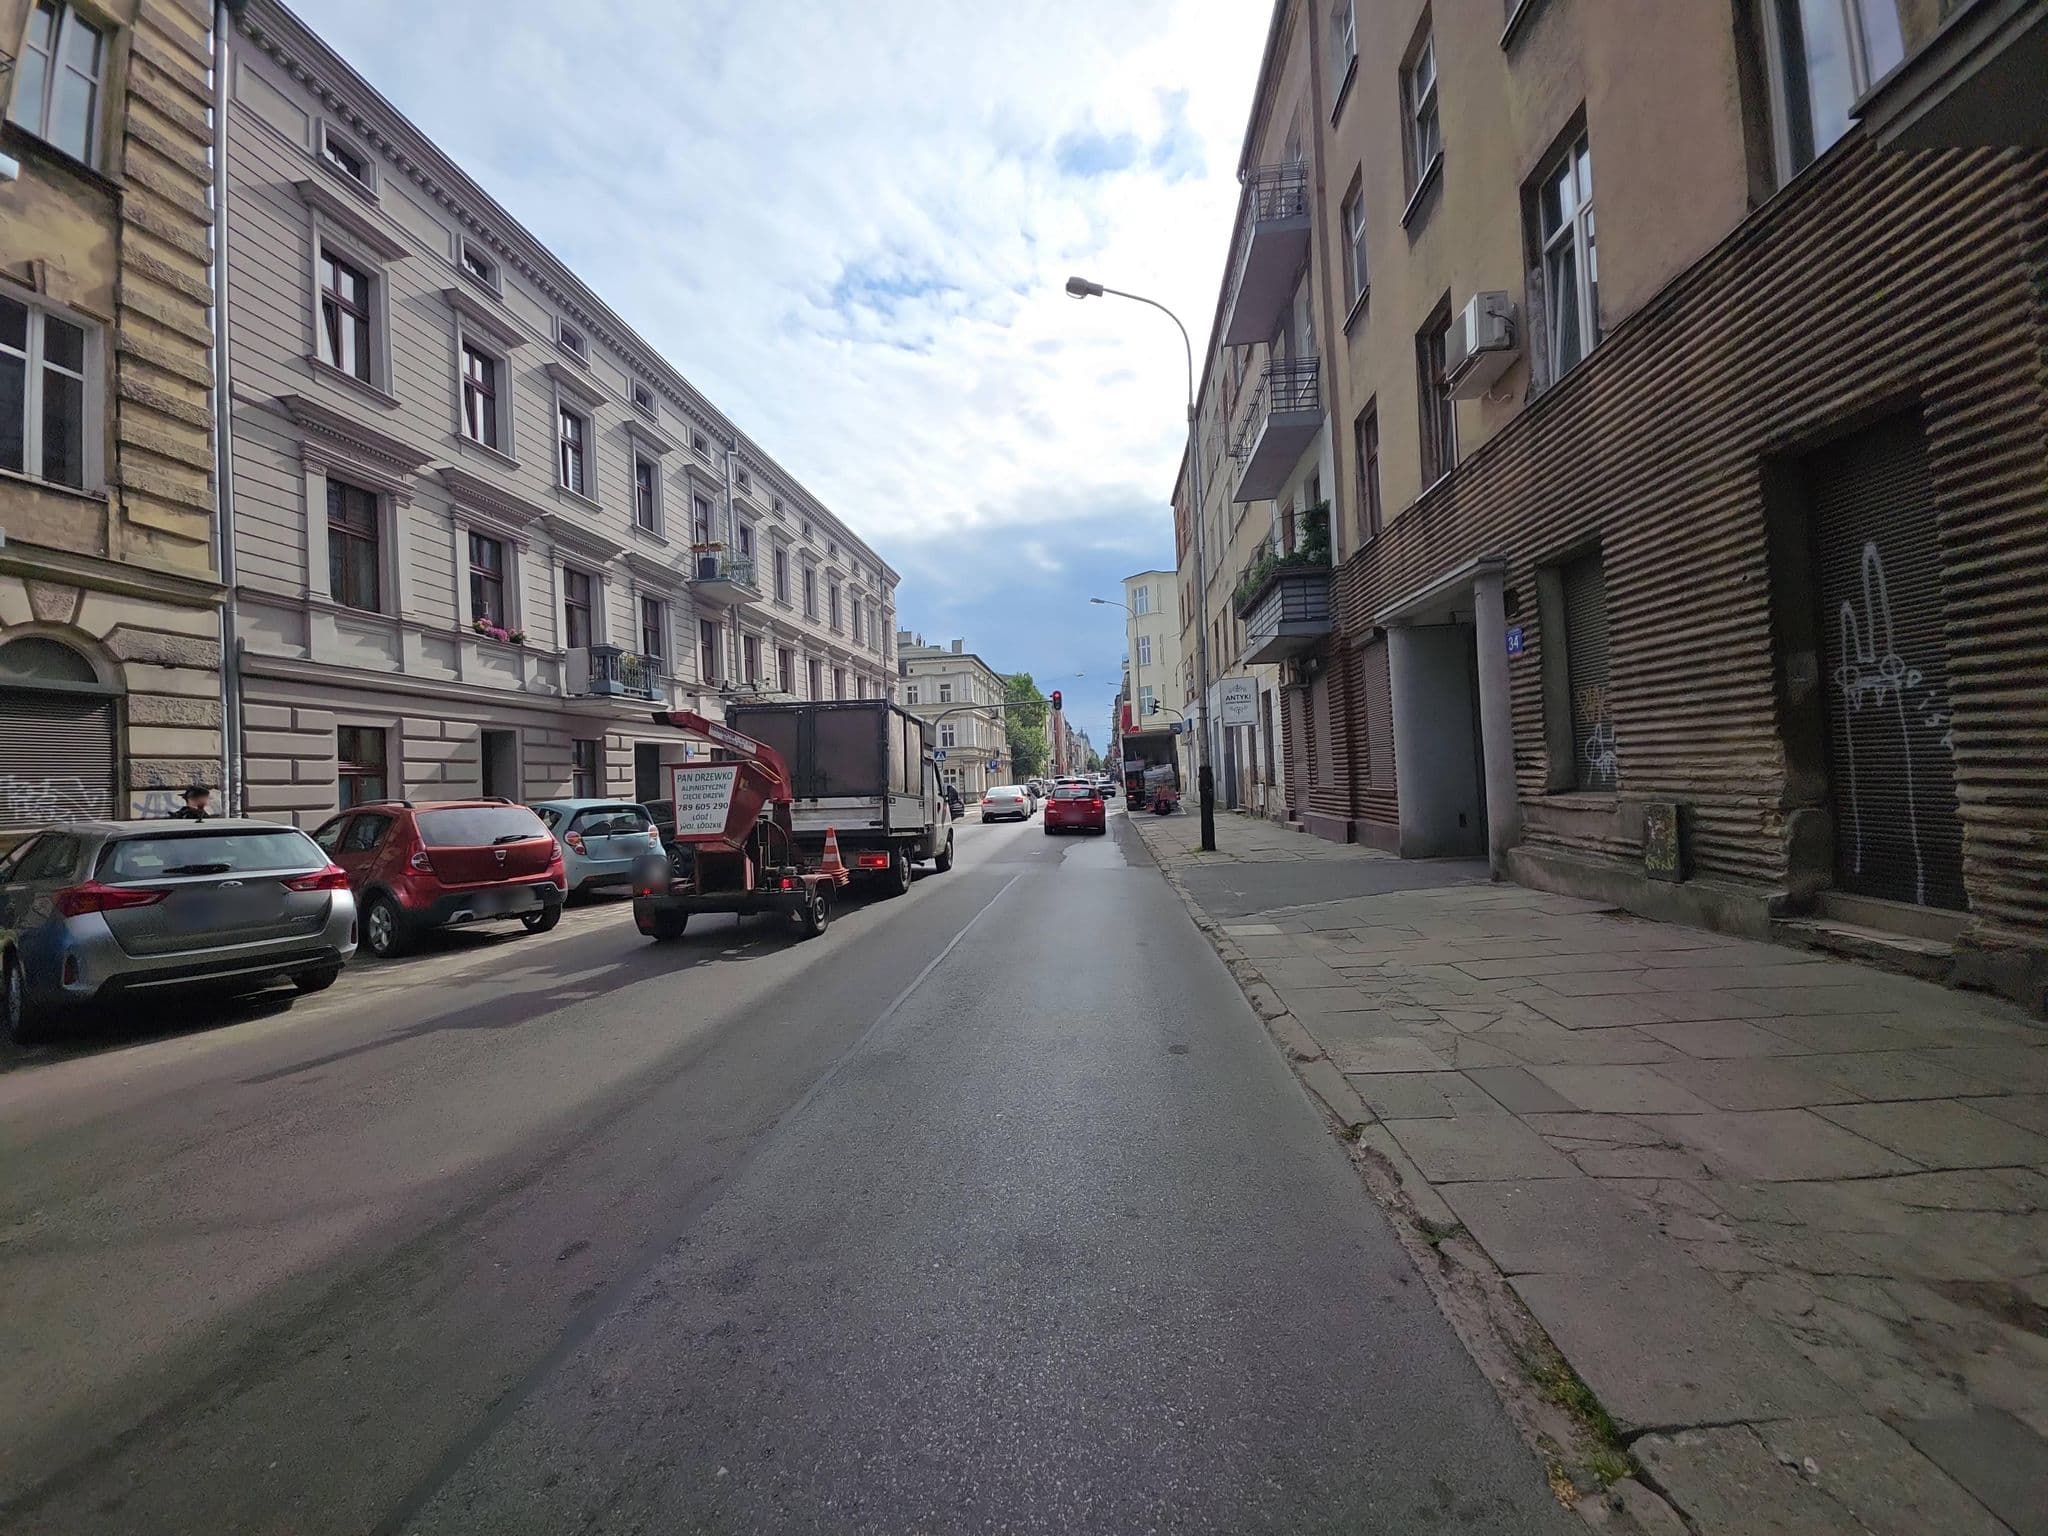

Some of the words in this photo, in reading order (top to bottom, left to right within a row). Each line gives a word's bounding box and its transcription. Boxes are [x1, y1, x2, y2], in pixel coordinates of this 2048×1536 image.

[1508, 635, 1519, 651] 34
[677, 773, 693, 782] PAN
[695, 772, 733, 781] DRZEWKO
[713, 802, 728, 810] 290
